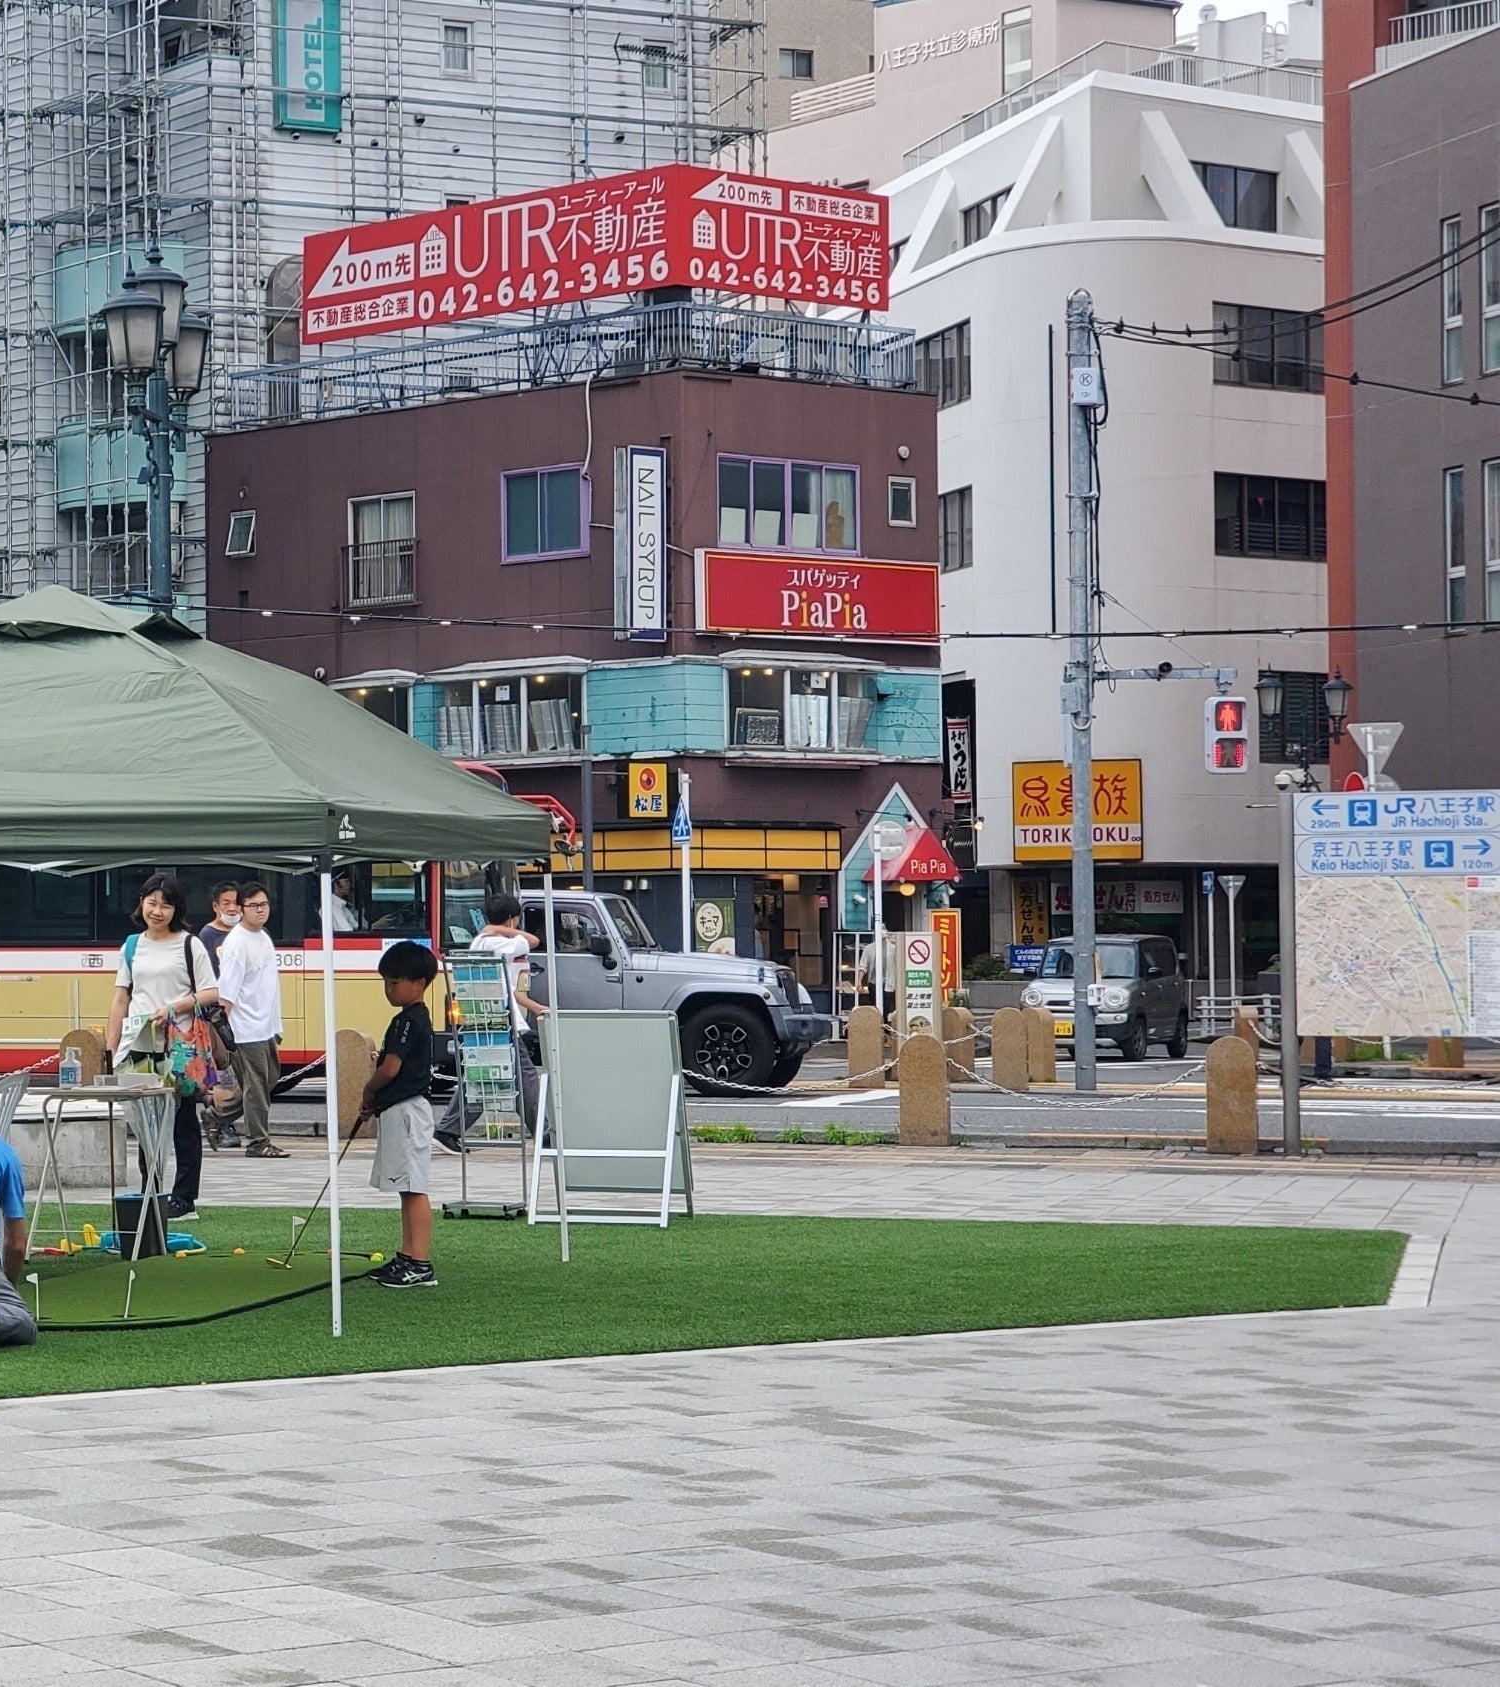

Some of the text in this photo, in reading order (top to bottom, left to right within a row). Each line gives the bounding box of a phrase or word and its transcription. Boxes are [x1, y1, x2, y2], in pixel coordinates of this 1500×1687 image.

[878, 19, 1001, 73] 八王子共立診療所
[304, 17, 323, 110] HOTEL
[558, 175, 665, 211] ユーティーアール
[718, 183, 772, 206] 200m先
[794, 195, 875, 221] 不動産総合企業
[803, 221, 882, 243] ユーティーアール
[332, 253, 411, 288] 200m先
[689, 257, 881, 305] 042-642-3456
[418, 249, 669, 320] 042-642-3456
[312, 297, 410, 329] 不動産総合企業
[638, 468, 656, 620] NAIL SYRUP
[786, 567, 861, 589] スパゲッティ
[781, 590, 868, 630] PiaPia
[635, 794, 663, 812] 松屋
[1311, 820, 1341, 829] 290m
[1391, 815, 1488, 829] JR Hachioji Sta.
[1020, 827, 1130, 844] TORIKOKU
[1312, 840, 1414, 858] 京王八王子駅
[911, 859, 947, 874] Pia Pia
[1311, 860, 1415, 872] Keio Hachioji Sta.
[1462, 860, 1493, 869] 120m
[1055, 885, 1124, 911] 処せん
[1125, 882, 1137, 912] 受付
[1143, 890, 1180, 903] 処方せん
